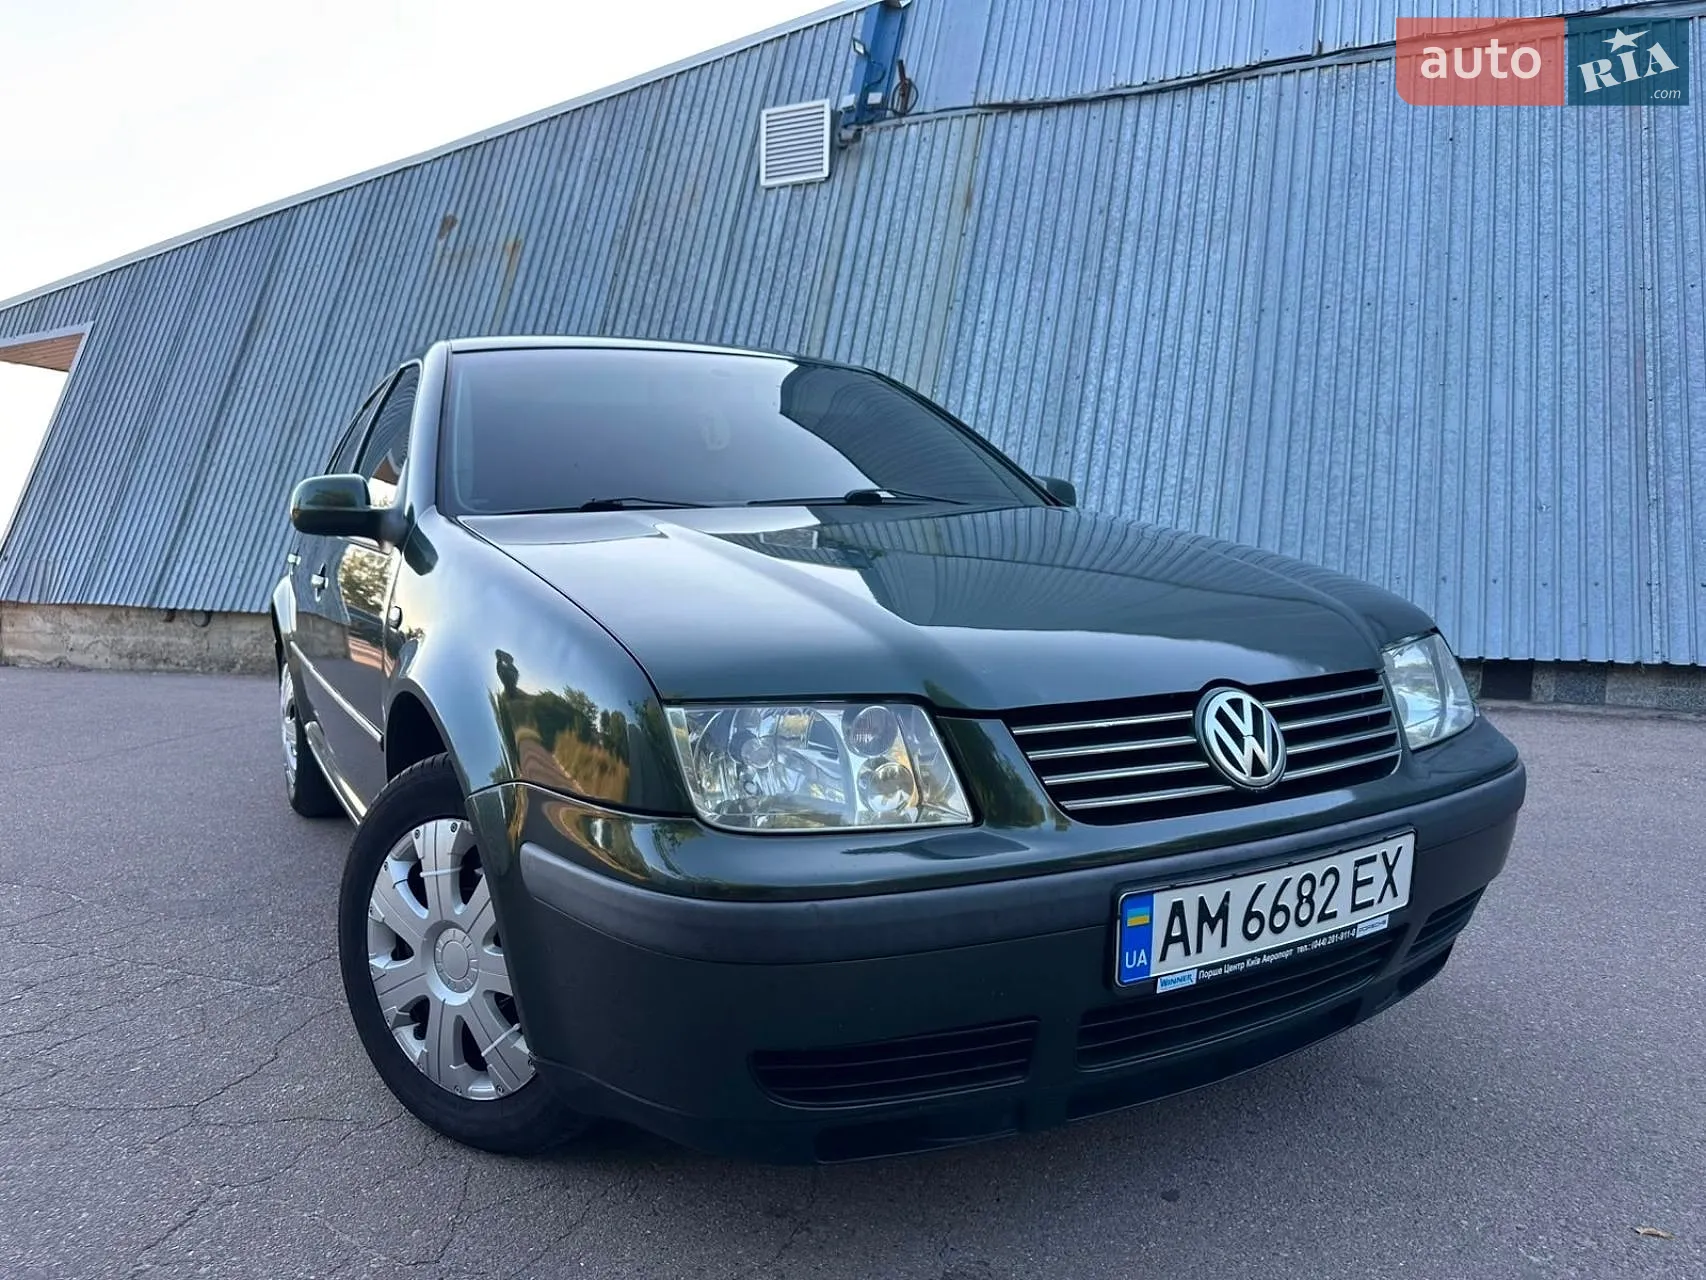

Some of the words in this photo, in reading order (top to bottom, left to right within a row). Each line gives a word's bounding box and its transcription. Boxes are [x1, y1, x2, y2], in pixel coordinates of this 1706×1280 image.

[1159, 889, 1231, 962] AM
[1241, 866, 1340, 940] 6682
[1350, 845, 1403, 912] EX
[1125, 949, 1148, 969] UA
[1198, 967, 1223, 980] Порше
[1223, 961, 1246, 974] Центр
